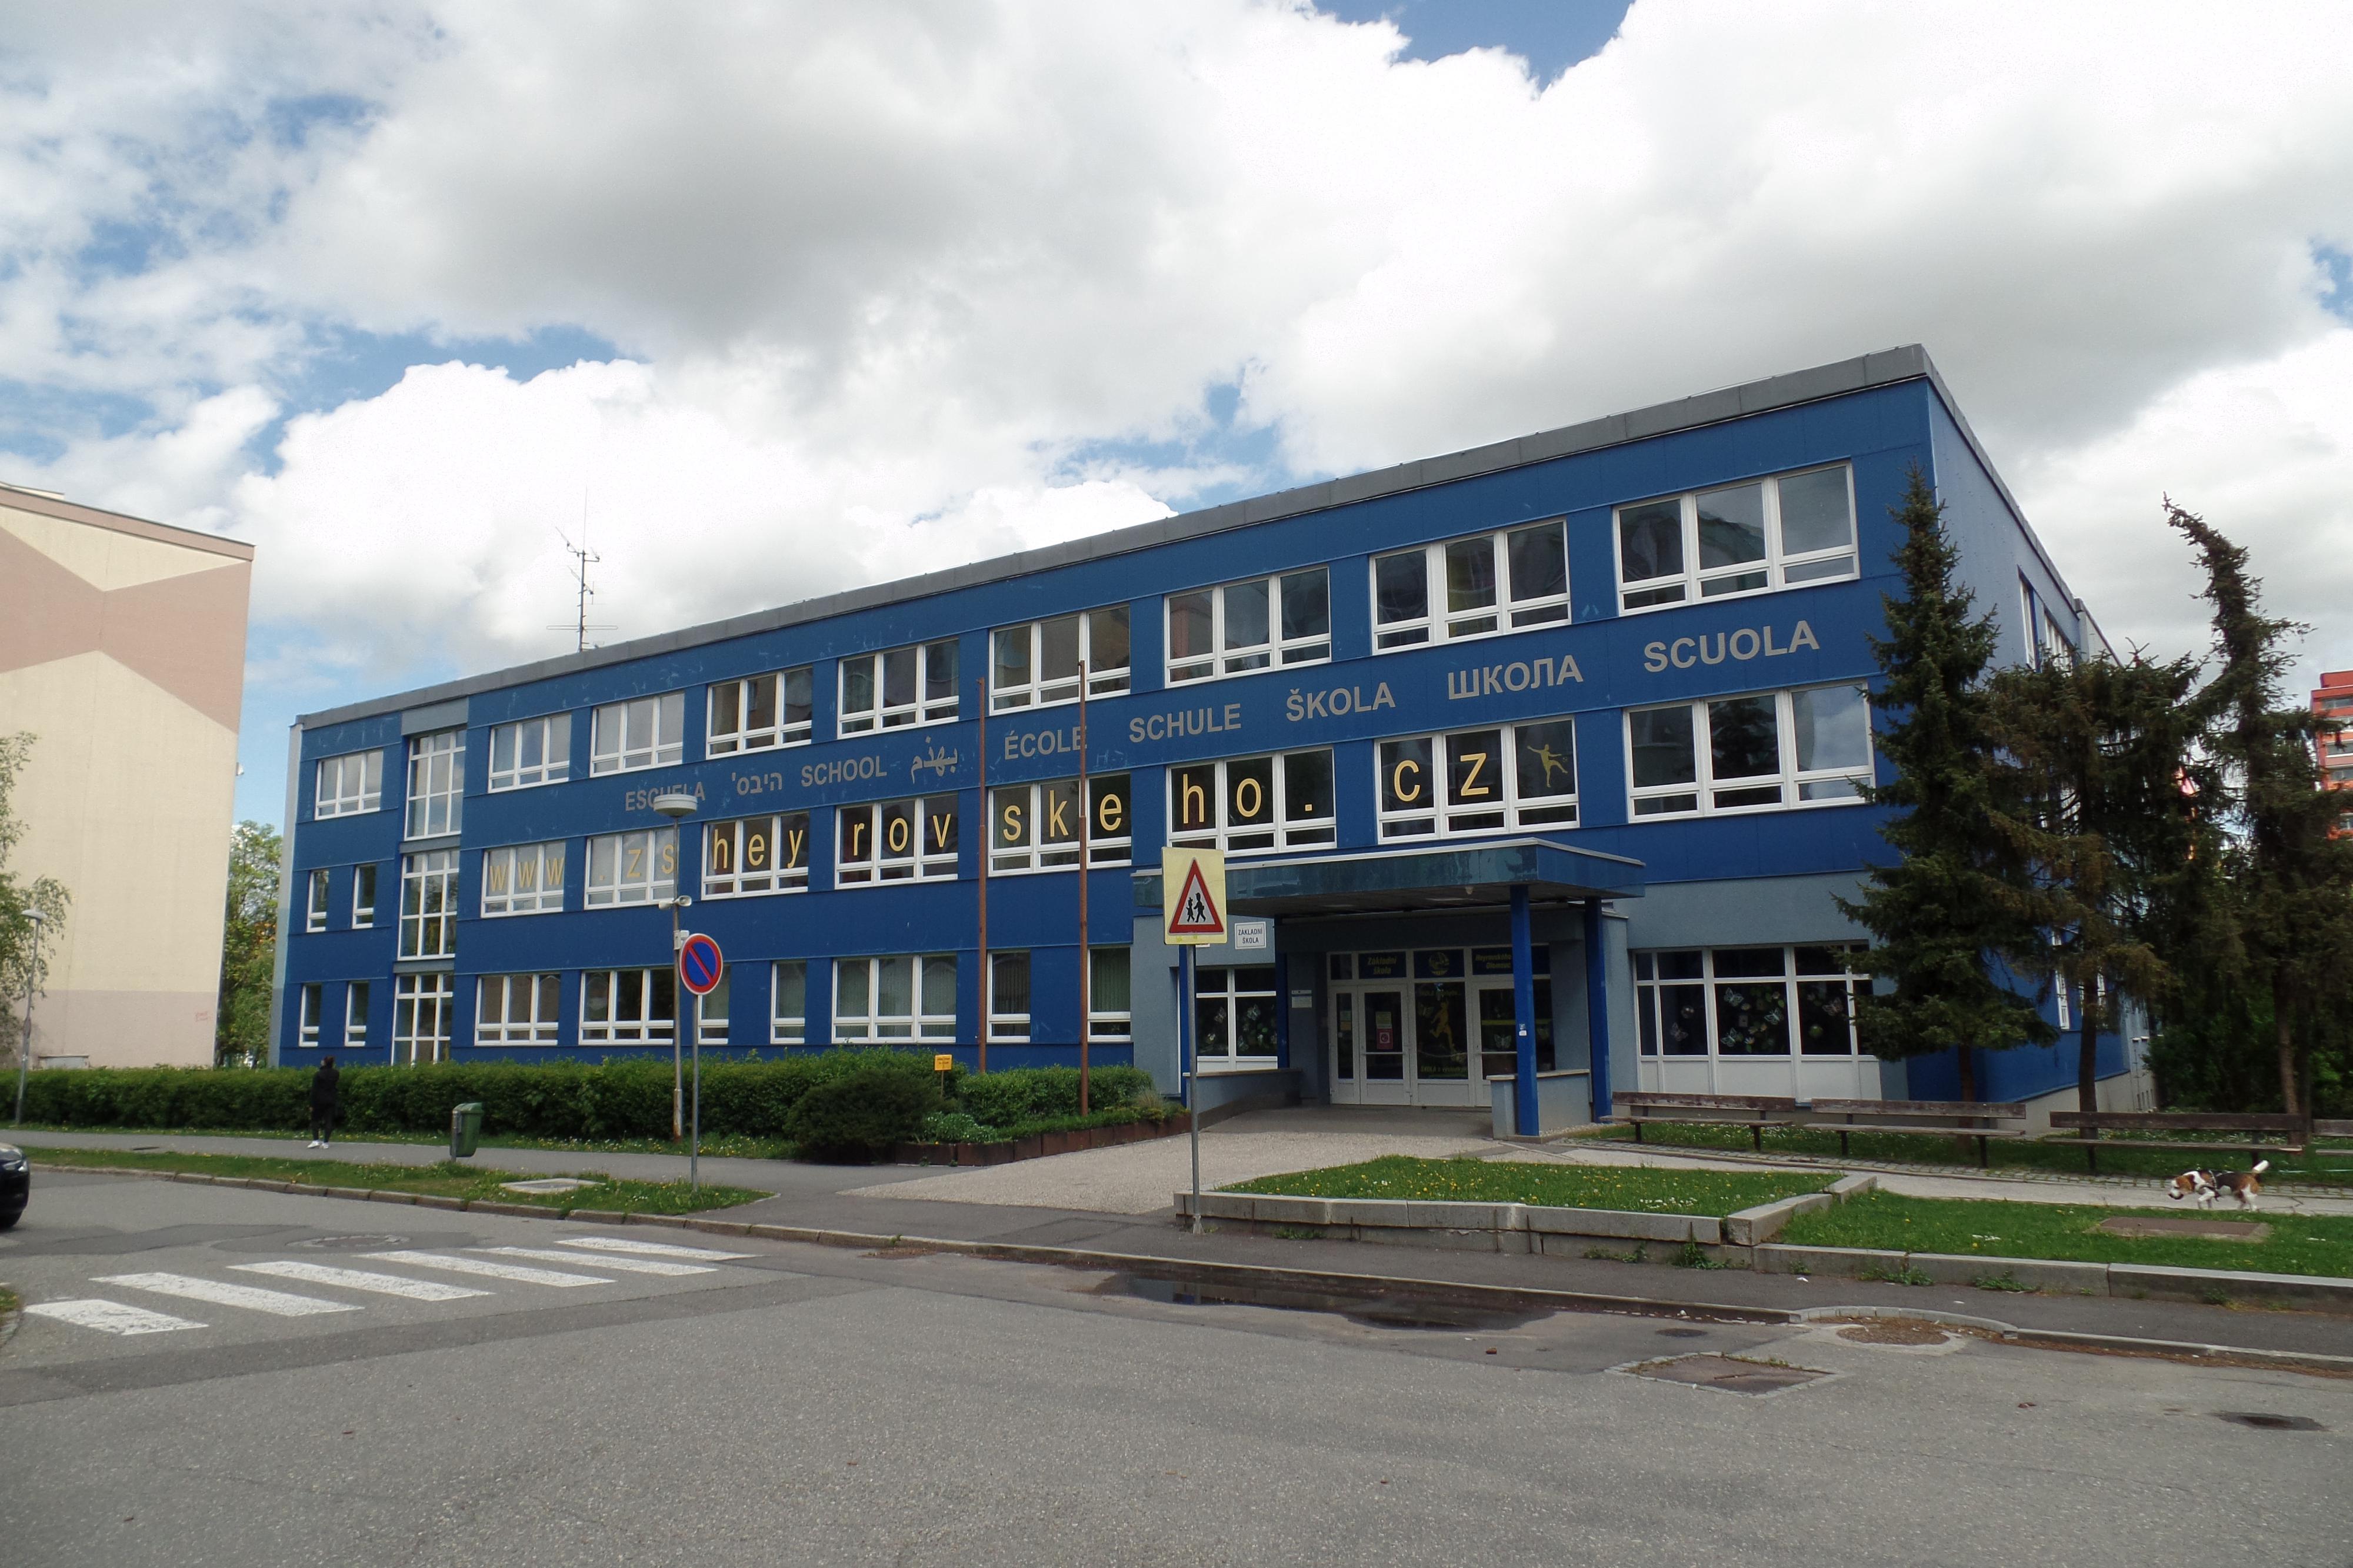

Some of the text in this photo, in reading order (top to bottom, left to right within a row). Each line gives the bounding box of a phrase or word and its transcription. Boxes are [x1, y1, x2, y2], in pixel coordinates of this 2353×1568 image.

[1644, 620, 1821, 672] SCUOLA
[1448, 654, 1584, 700] ШКОЛА
[1005, 681, 1396, 760] ÉCOLE SCHULE ŠKOLA
[801, 756, 887, 787] SCHOOL
[1238, 926, 1263, 936] ZÁKLADNÍ
